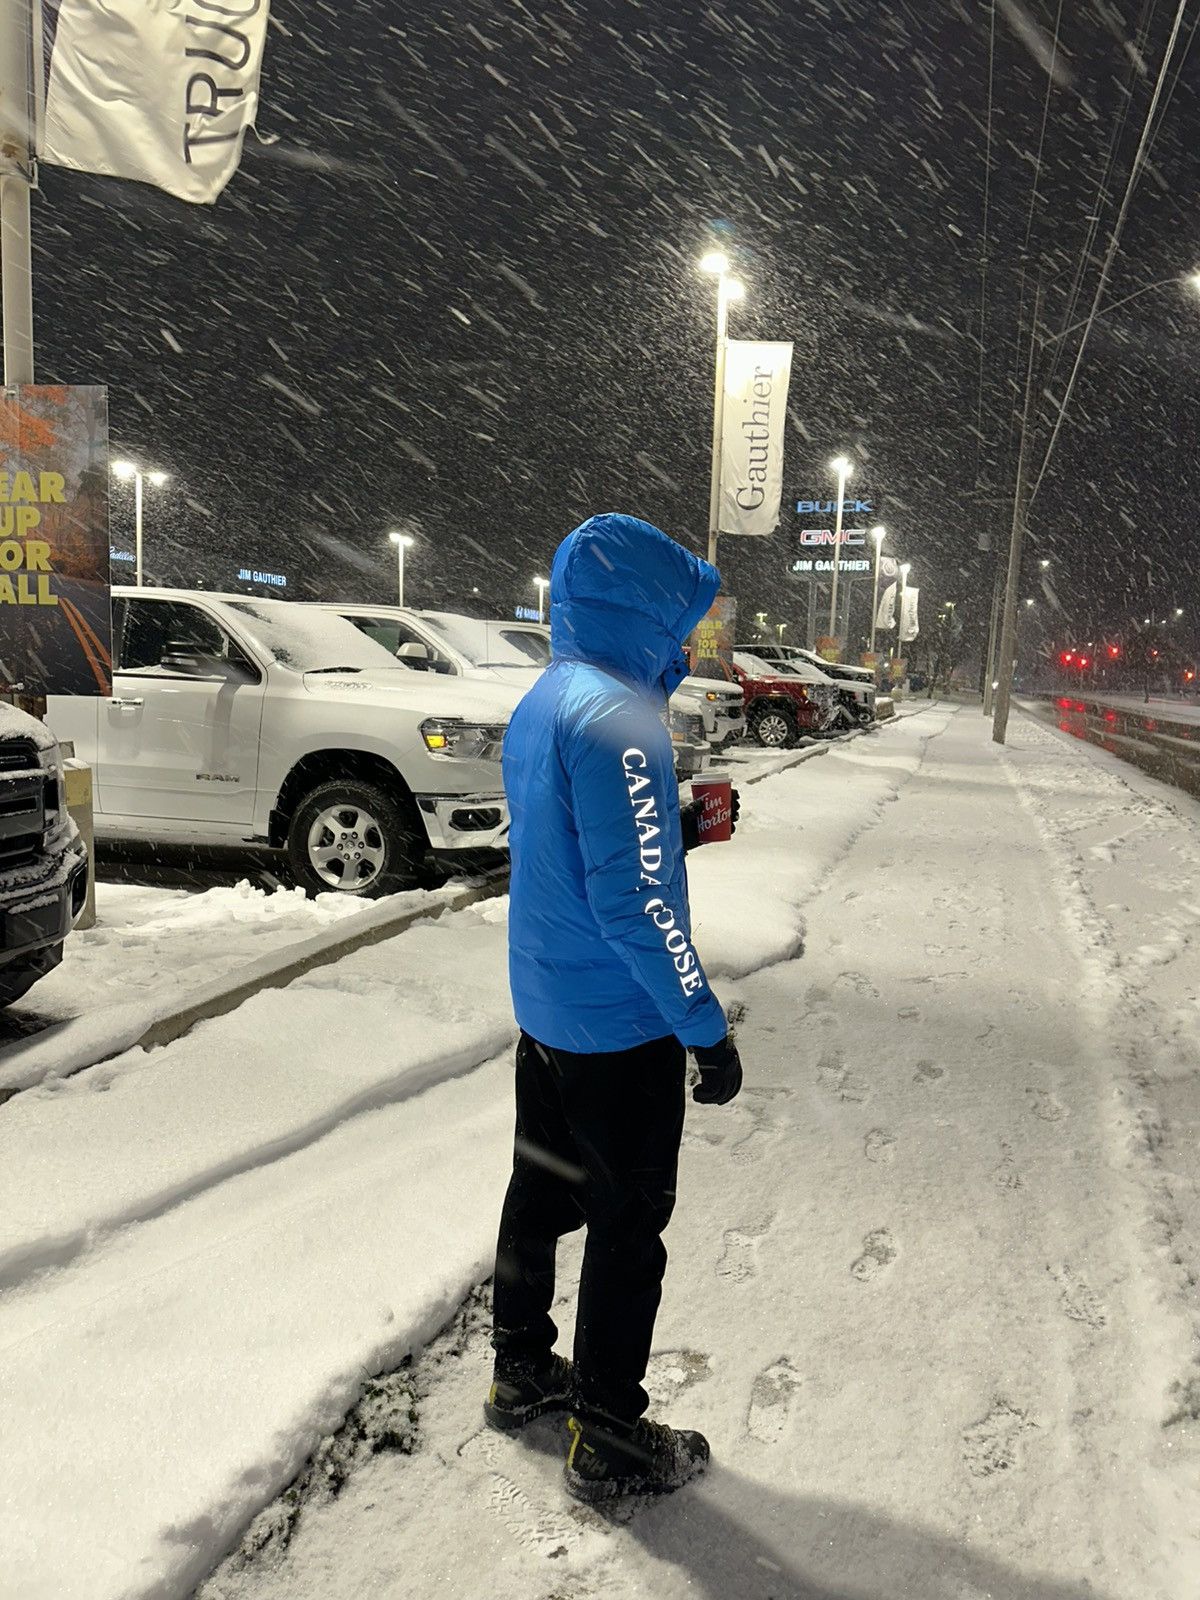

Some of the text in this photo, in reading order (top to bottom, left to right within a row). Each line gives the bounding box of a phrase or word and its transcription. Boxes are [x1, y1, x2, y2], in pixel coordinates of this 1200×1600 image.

[735, 366, 774, 511] Gauthier
[797, 500, 873, 513] BUICK
[0, 506, 41, 537] UP
[800, 529, 866, 545] GMC
[793, 561, 813, 571] JIM
[237, 569, 287, 586] JIM GAUTHIER
[701, 630, 715, 638] UP
[196, 773, 240, 783] RAM
